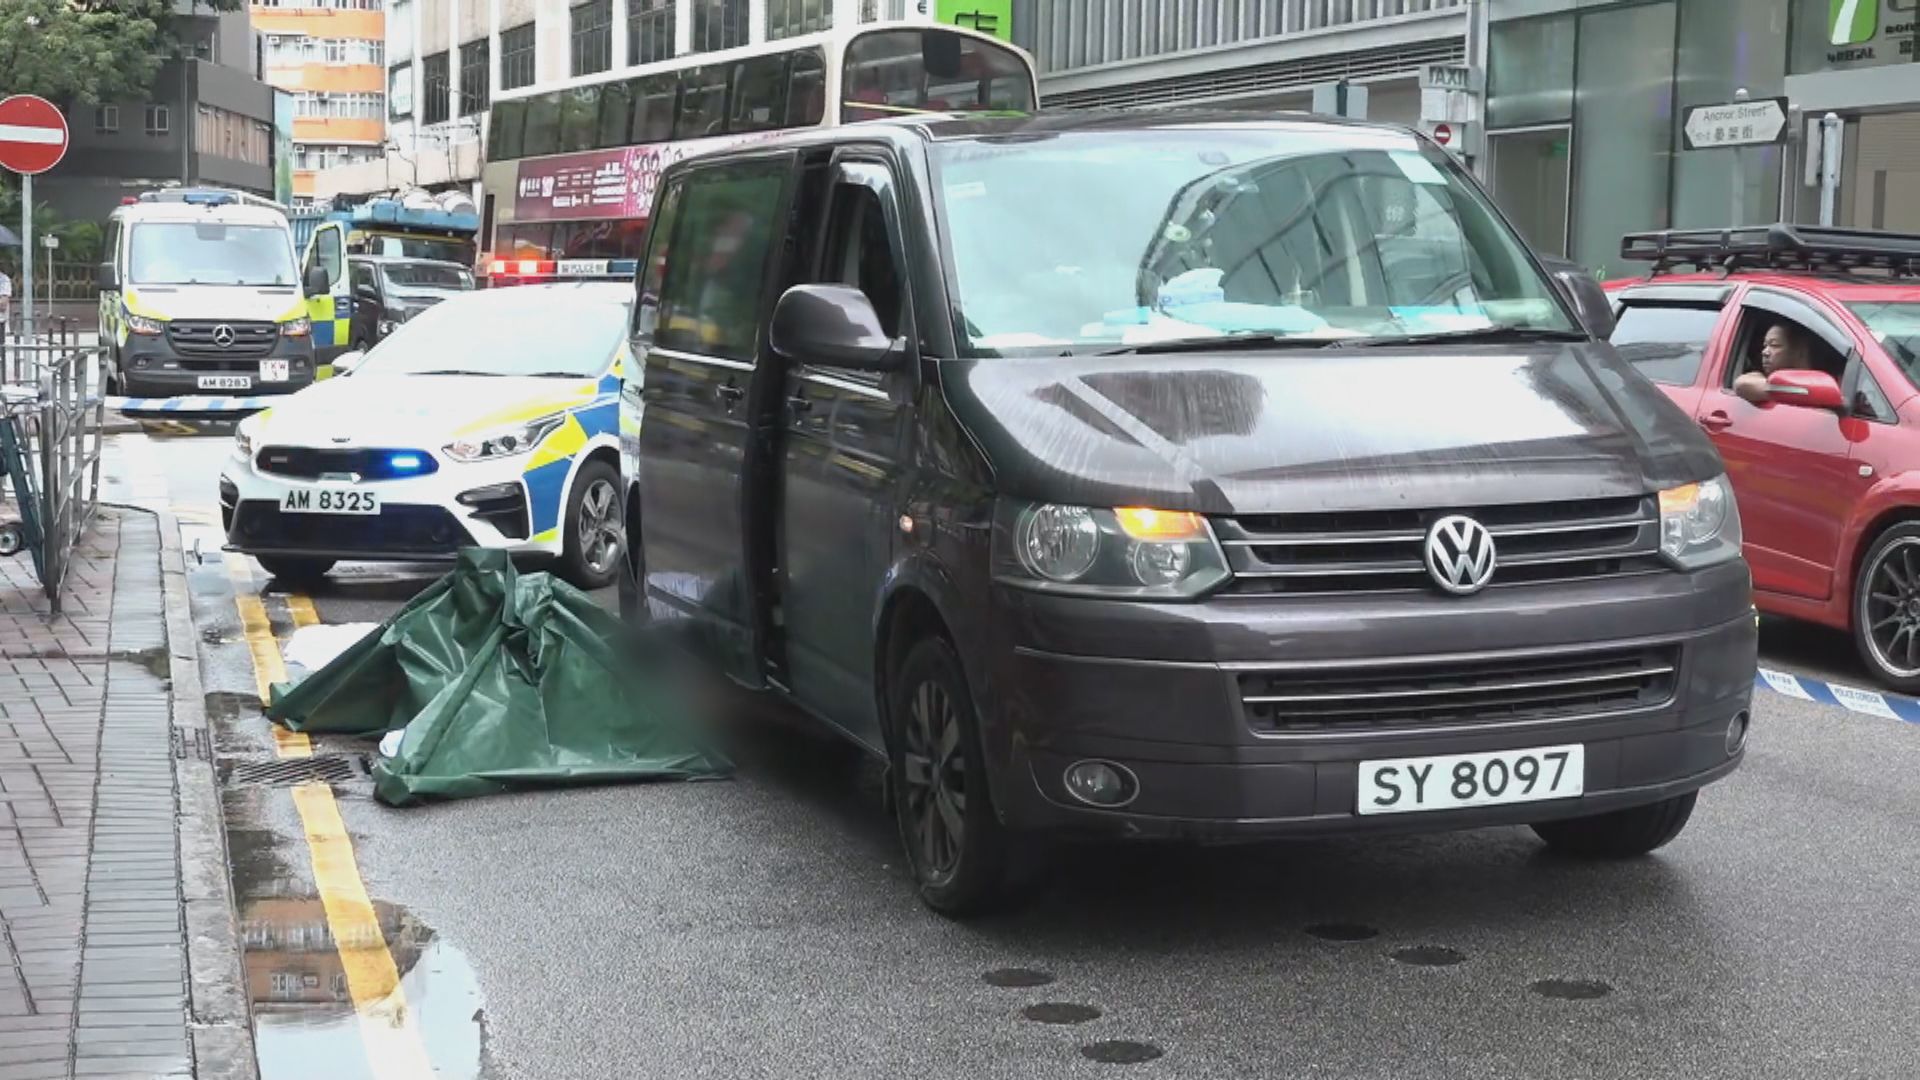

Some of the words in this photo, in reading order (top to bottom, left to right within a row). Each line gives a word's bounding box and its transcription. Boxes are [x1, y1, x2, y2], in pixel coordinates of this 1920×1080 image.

[1703, 109, 1735, 121] Anchor
[1737, 105, 1767, 119] Street
[202, 377, 217, 387] AM
[285, 489, 310, 510] AM
[319, 491, 375, 511] 8325
[1373, 764, 1434, 806] SY
[1450, 751, 1570, 800] 8097
